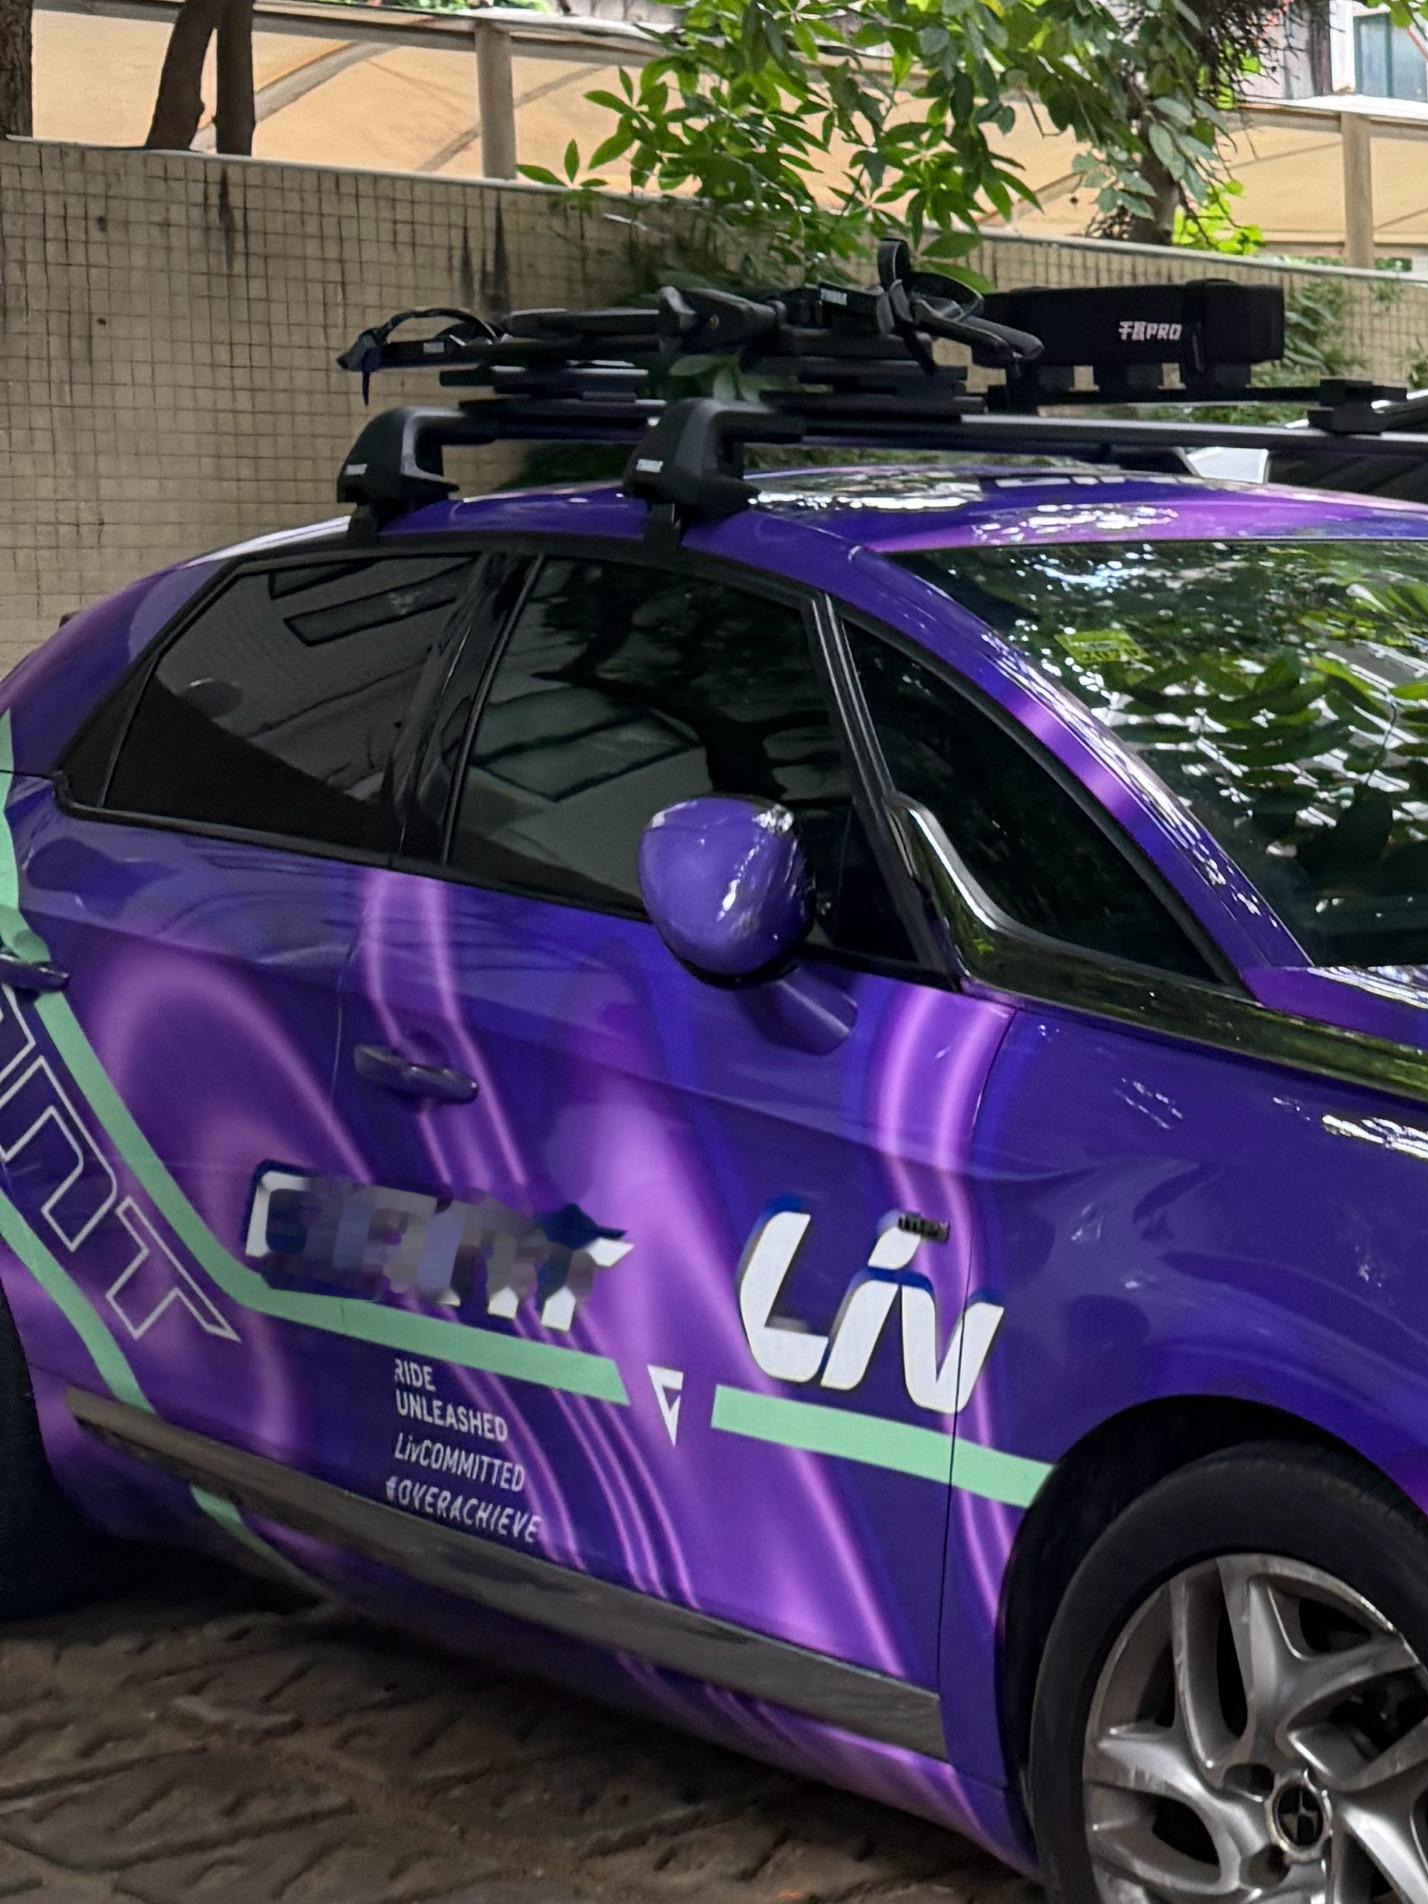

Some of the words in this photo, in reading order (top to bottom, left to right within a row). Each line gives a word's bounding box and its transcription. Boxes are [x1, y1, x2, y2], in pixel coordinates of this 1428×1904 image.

[739, 1210, 1005, 1415] Liv
[394, 1357, 437, 1392] RIDE
[395, 1389, 509, 1442] UNLEASHED
[394, 1432, 526, 1492] LivCOMMITTED
[385, 1475, 543, 1543] #OVERACHIEVE
